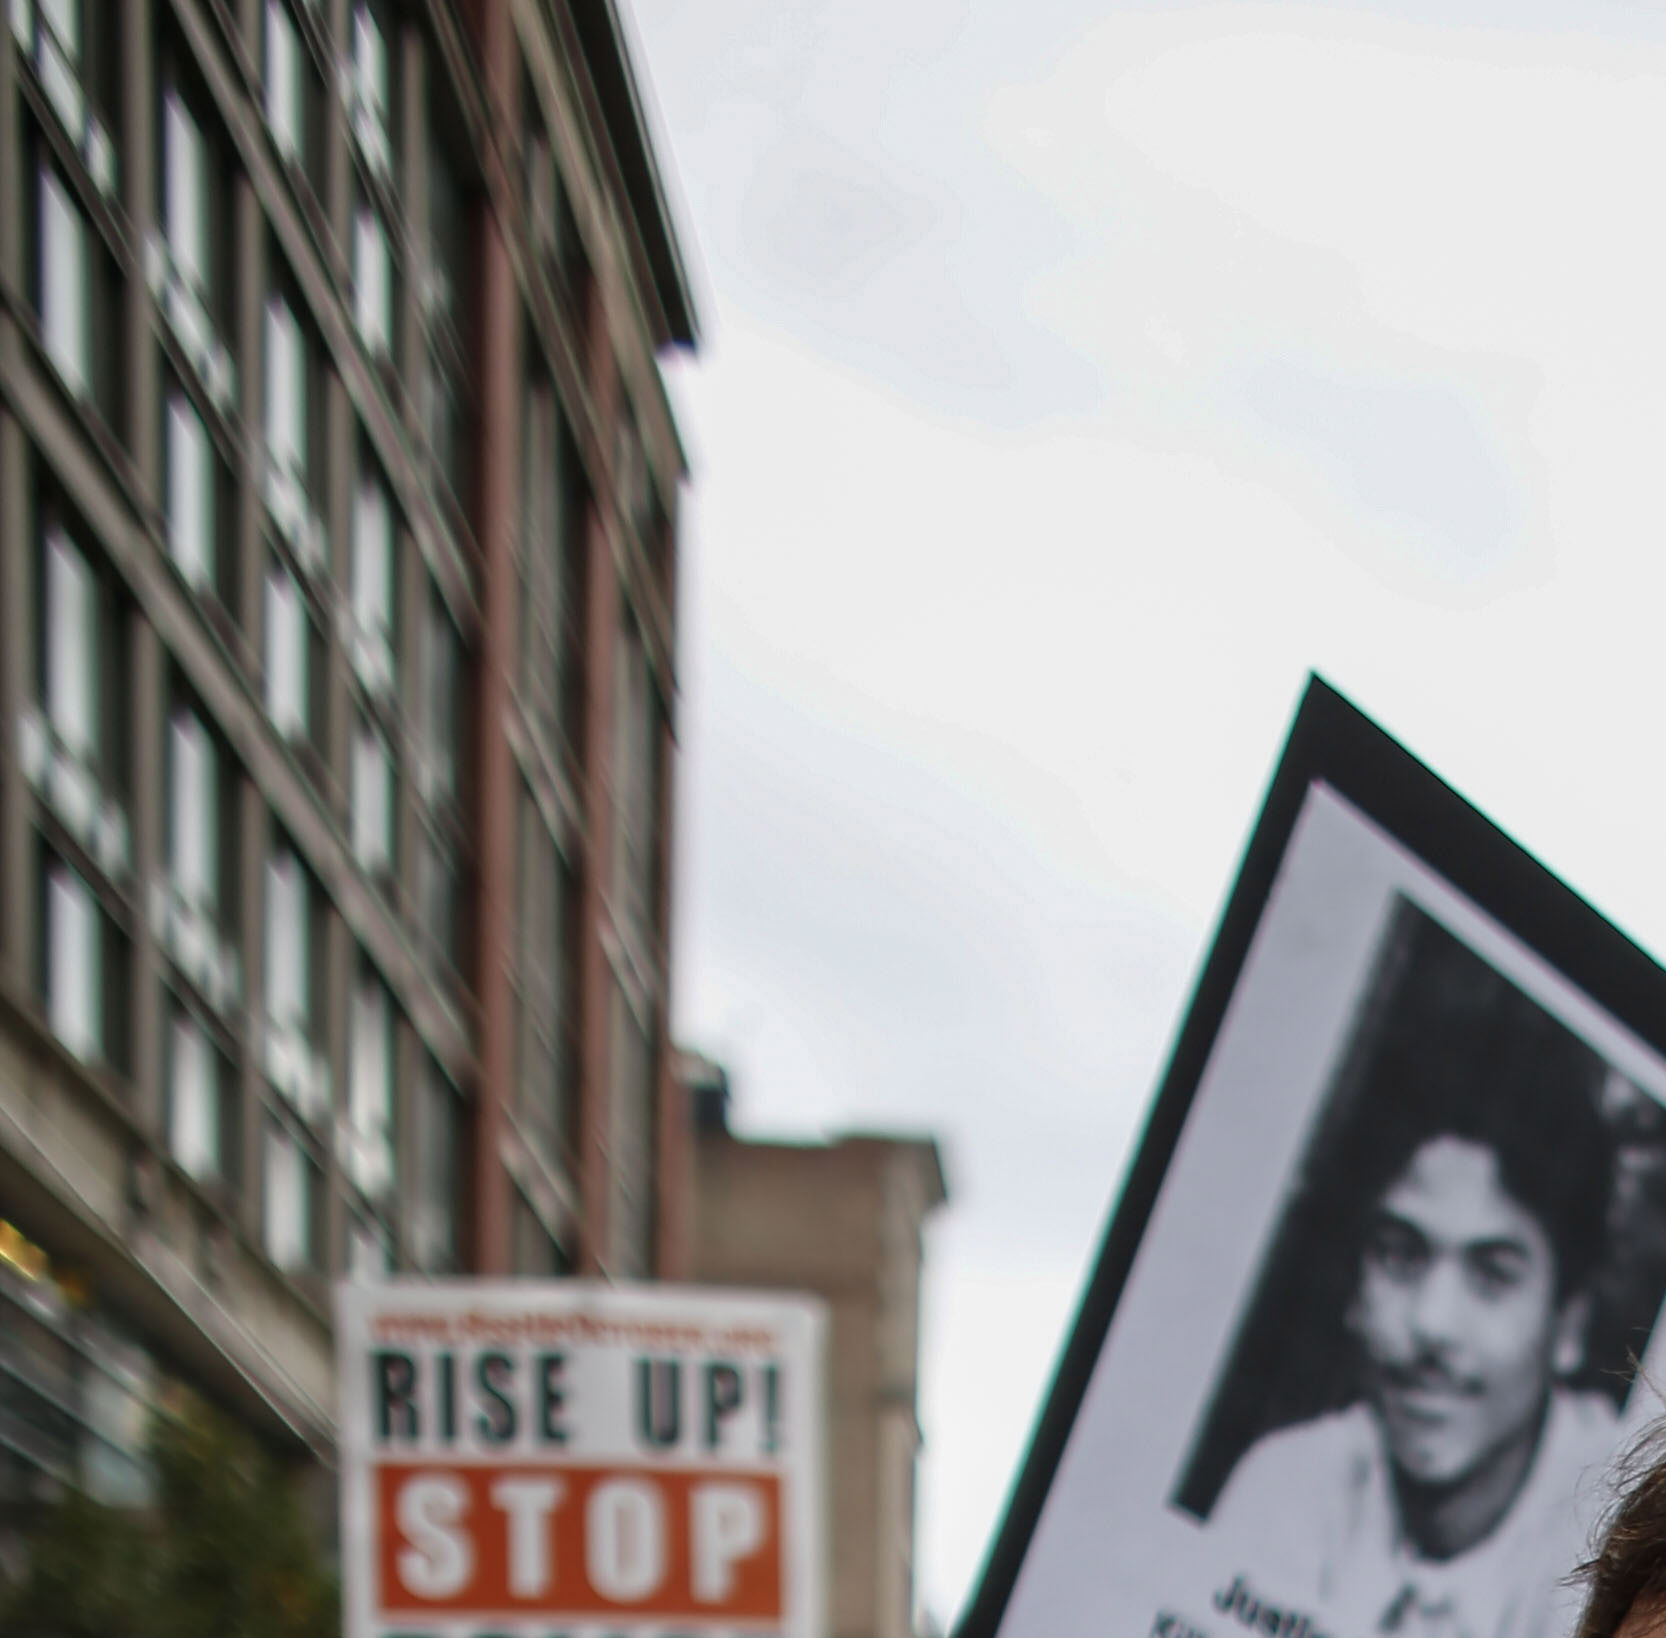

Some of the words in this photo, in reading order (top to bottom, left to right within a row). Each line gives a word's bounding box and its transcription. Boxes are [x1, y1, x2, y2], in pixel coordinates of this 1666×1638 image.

[371, 1349, 571, 1446] RISE
[632, 1355, 781, 1455] UP!
[397, 1475, 768, 1602] STOP
